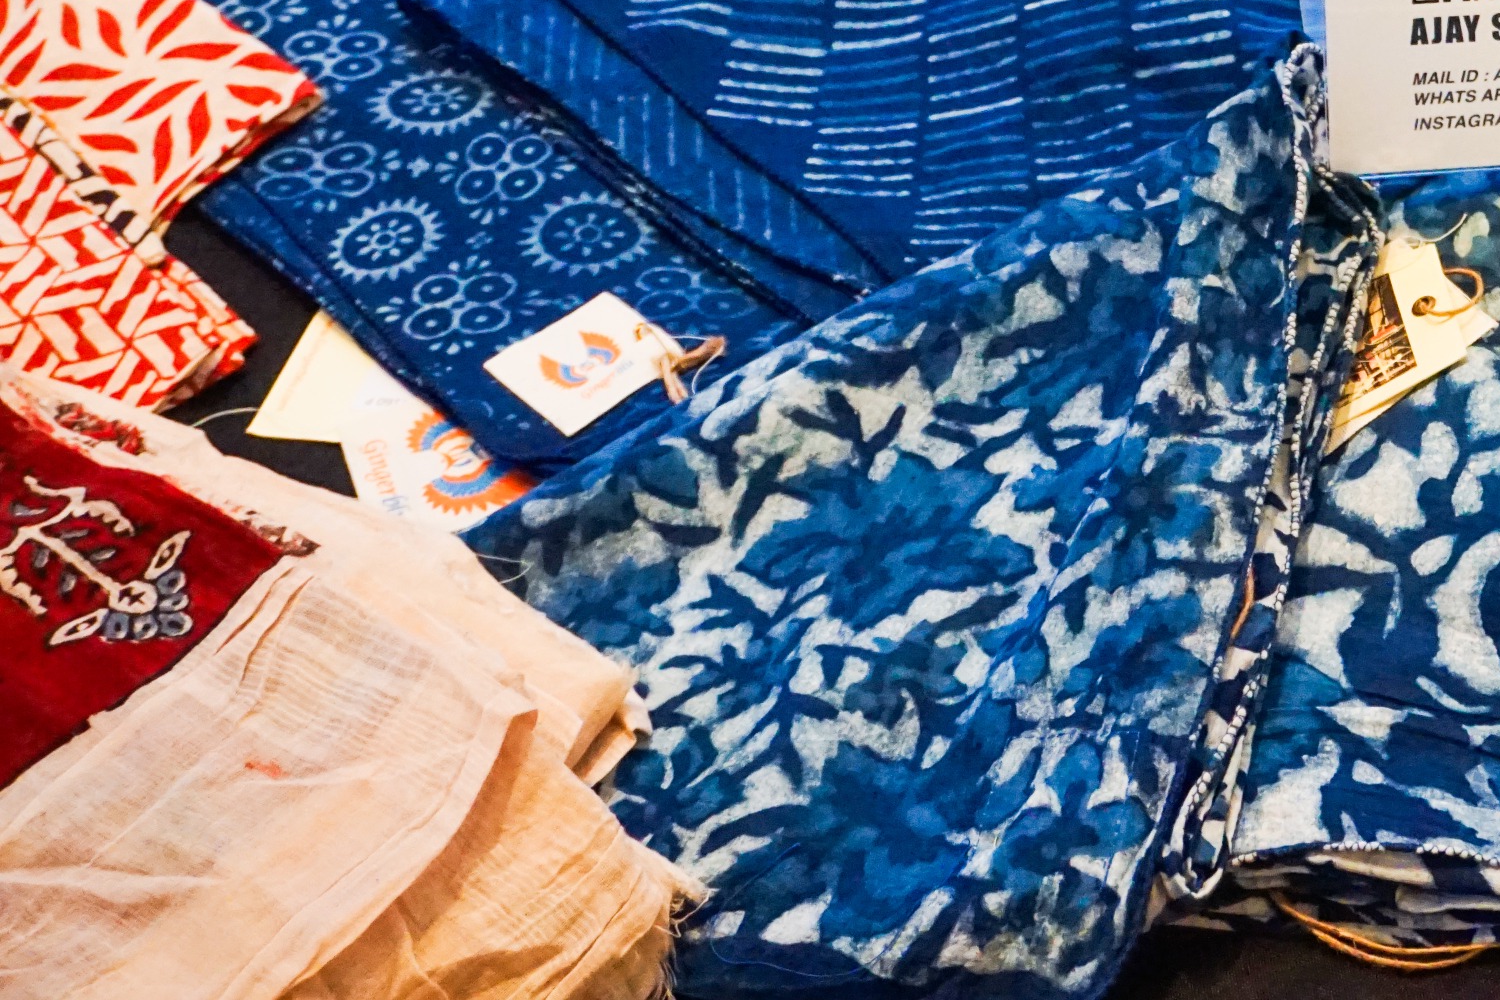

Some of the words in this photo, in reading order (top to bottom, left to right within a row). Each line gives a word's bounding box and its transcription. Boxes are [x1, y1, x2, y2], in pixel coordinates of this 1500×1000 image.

[1409, 13, 1481, 46] AJAY
[1412, 70, 1456, 86] MAIL
[1460, 69, 1479, 84] ID
[1414, 89, 1477, 106] WHATS
